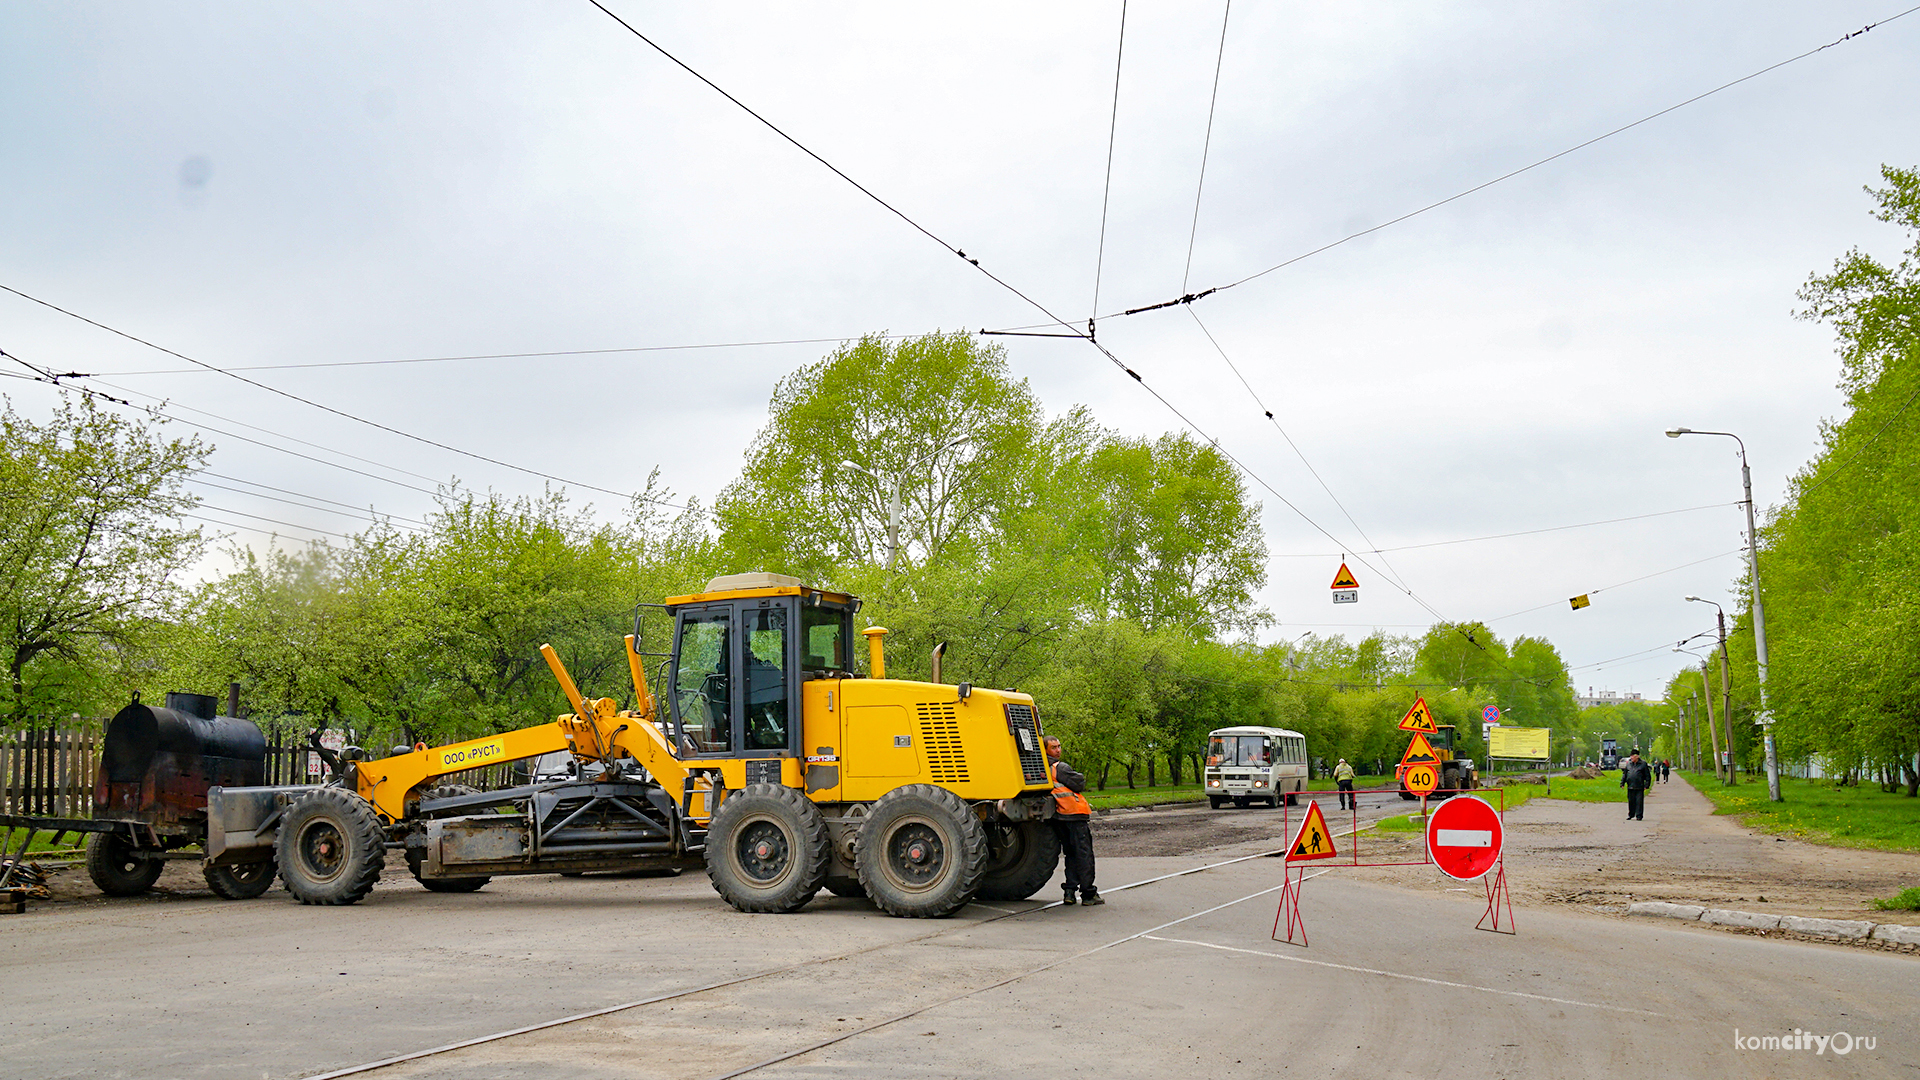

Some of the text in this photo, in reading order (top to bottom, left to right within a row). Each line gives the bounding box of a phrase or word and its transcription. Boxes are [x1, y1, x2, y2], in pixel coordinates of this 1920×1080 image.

[444, 744, 501, 765] ООО «РУСТ»
[1411, 773, 1431, 786] 40
